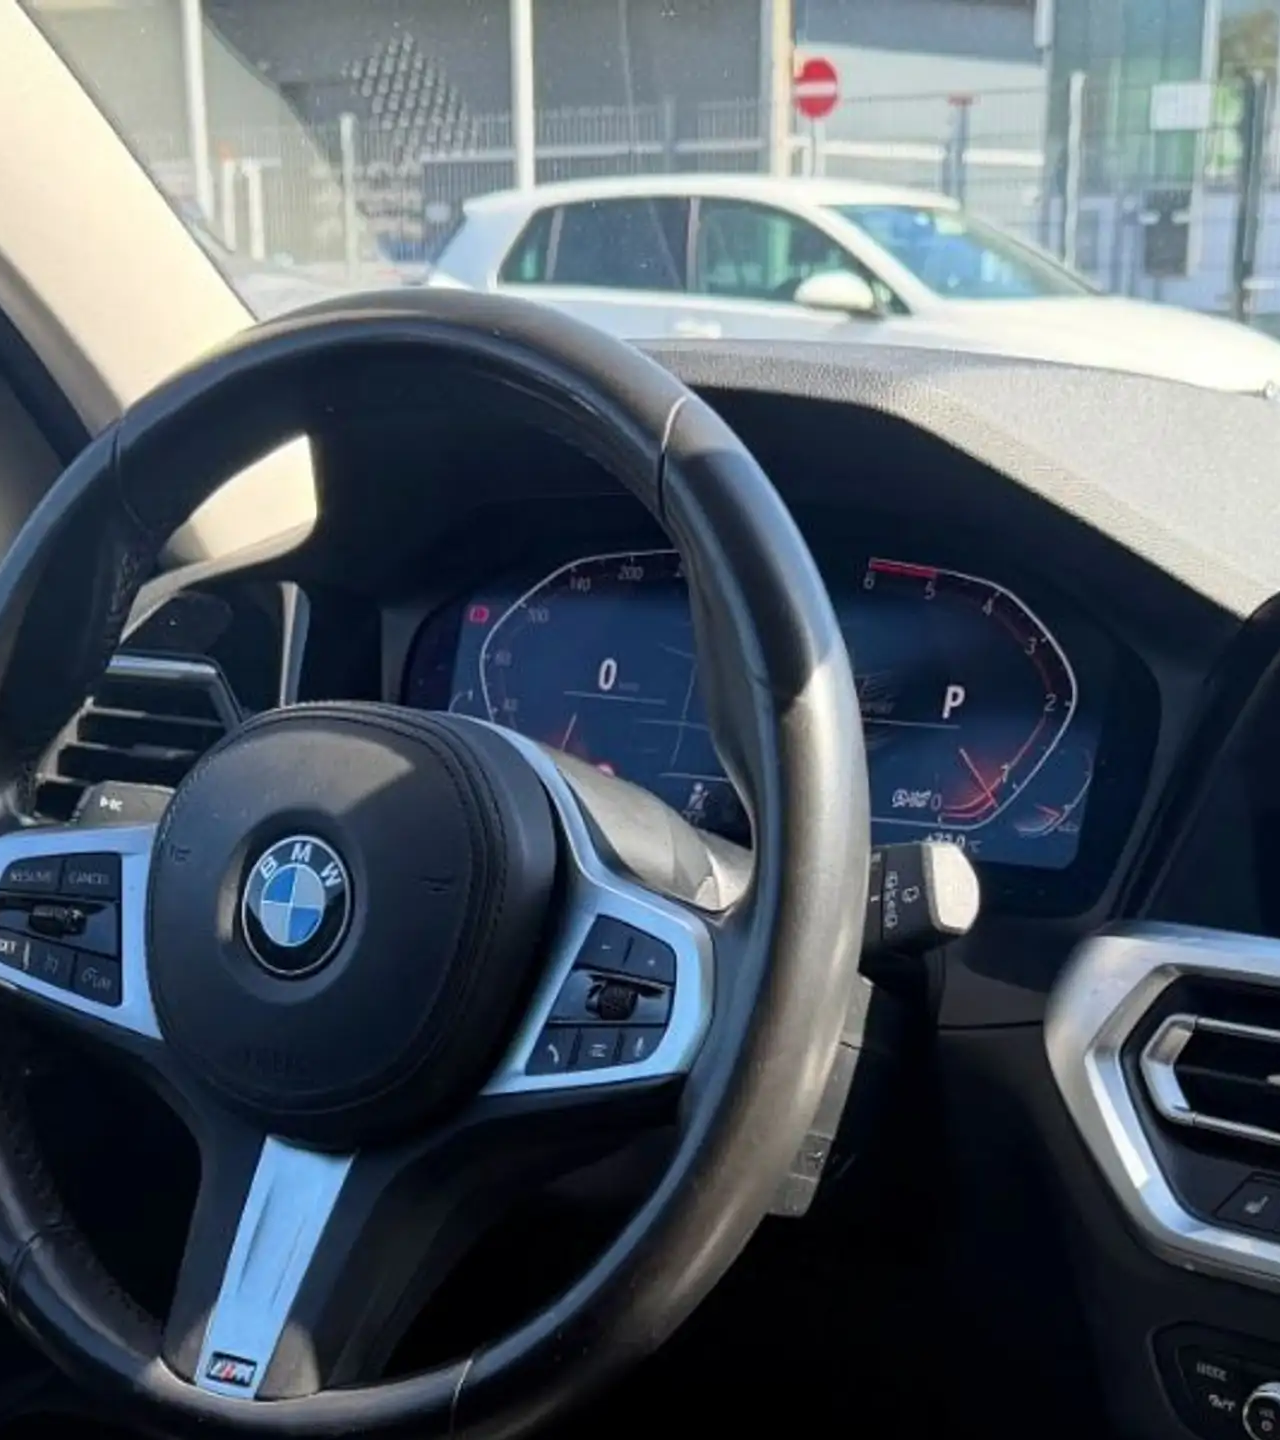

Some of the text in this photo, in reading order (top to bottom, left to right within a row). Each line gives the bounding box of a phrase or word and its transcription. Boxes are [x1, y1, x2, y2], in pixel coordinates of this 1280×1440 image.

[598, 658, 617, 690] 0
[942, 685, 965, 719] P
[1045, 694, 1057, 711] 2
[260, 842, 342, 887] BMW
